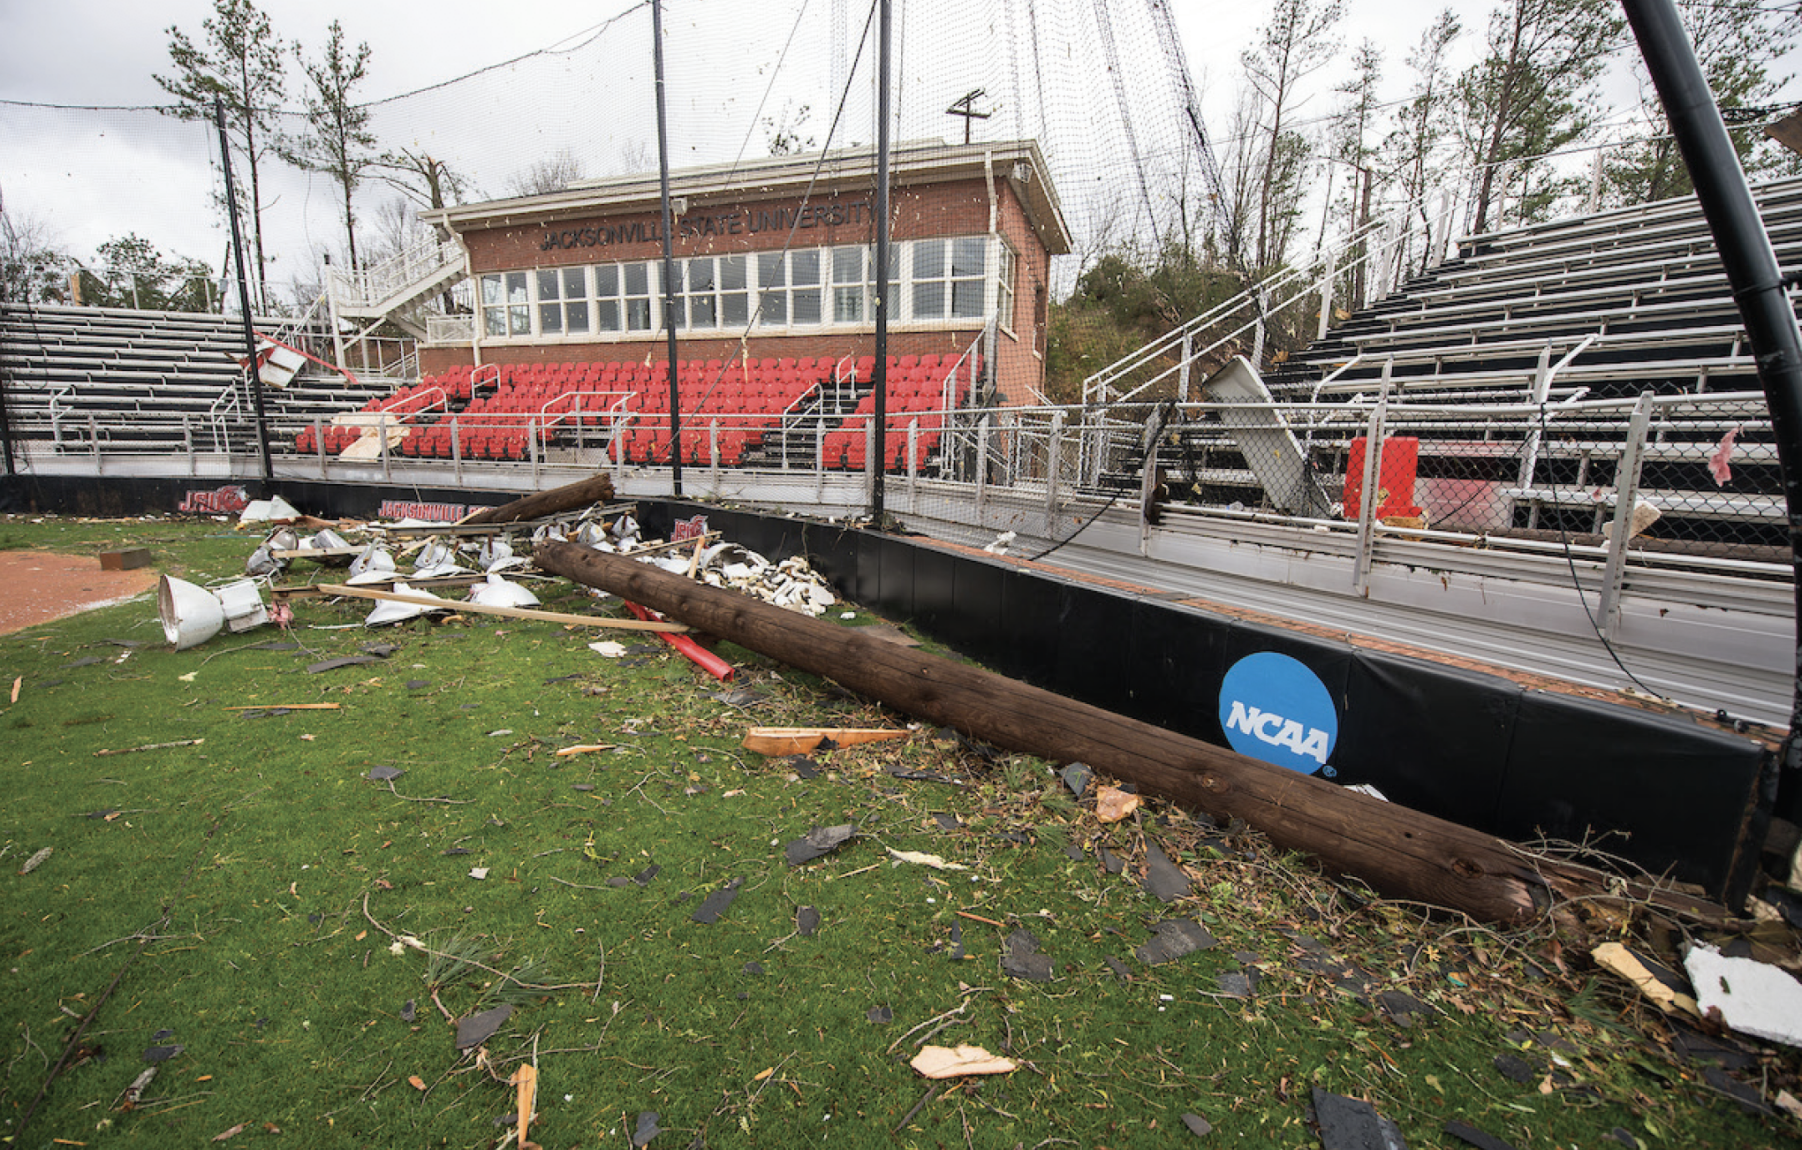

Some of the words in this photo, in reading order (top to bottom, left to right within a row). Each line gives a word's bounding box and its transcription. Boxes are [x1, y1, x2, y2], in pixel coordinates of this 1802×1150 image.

[680, 211, 742, 237] STATE
[748, 201, 879, 233] UNIVERSITY
[378, 500, 466, 522] JACKSONVILLE
[1226, 700, 1329, 765] NCAA
